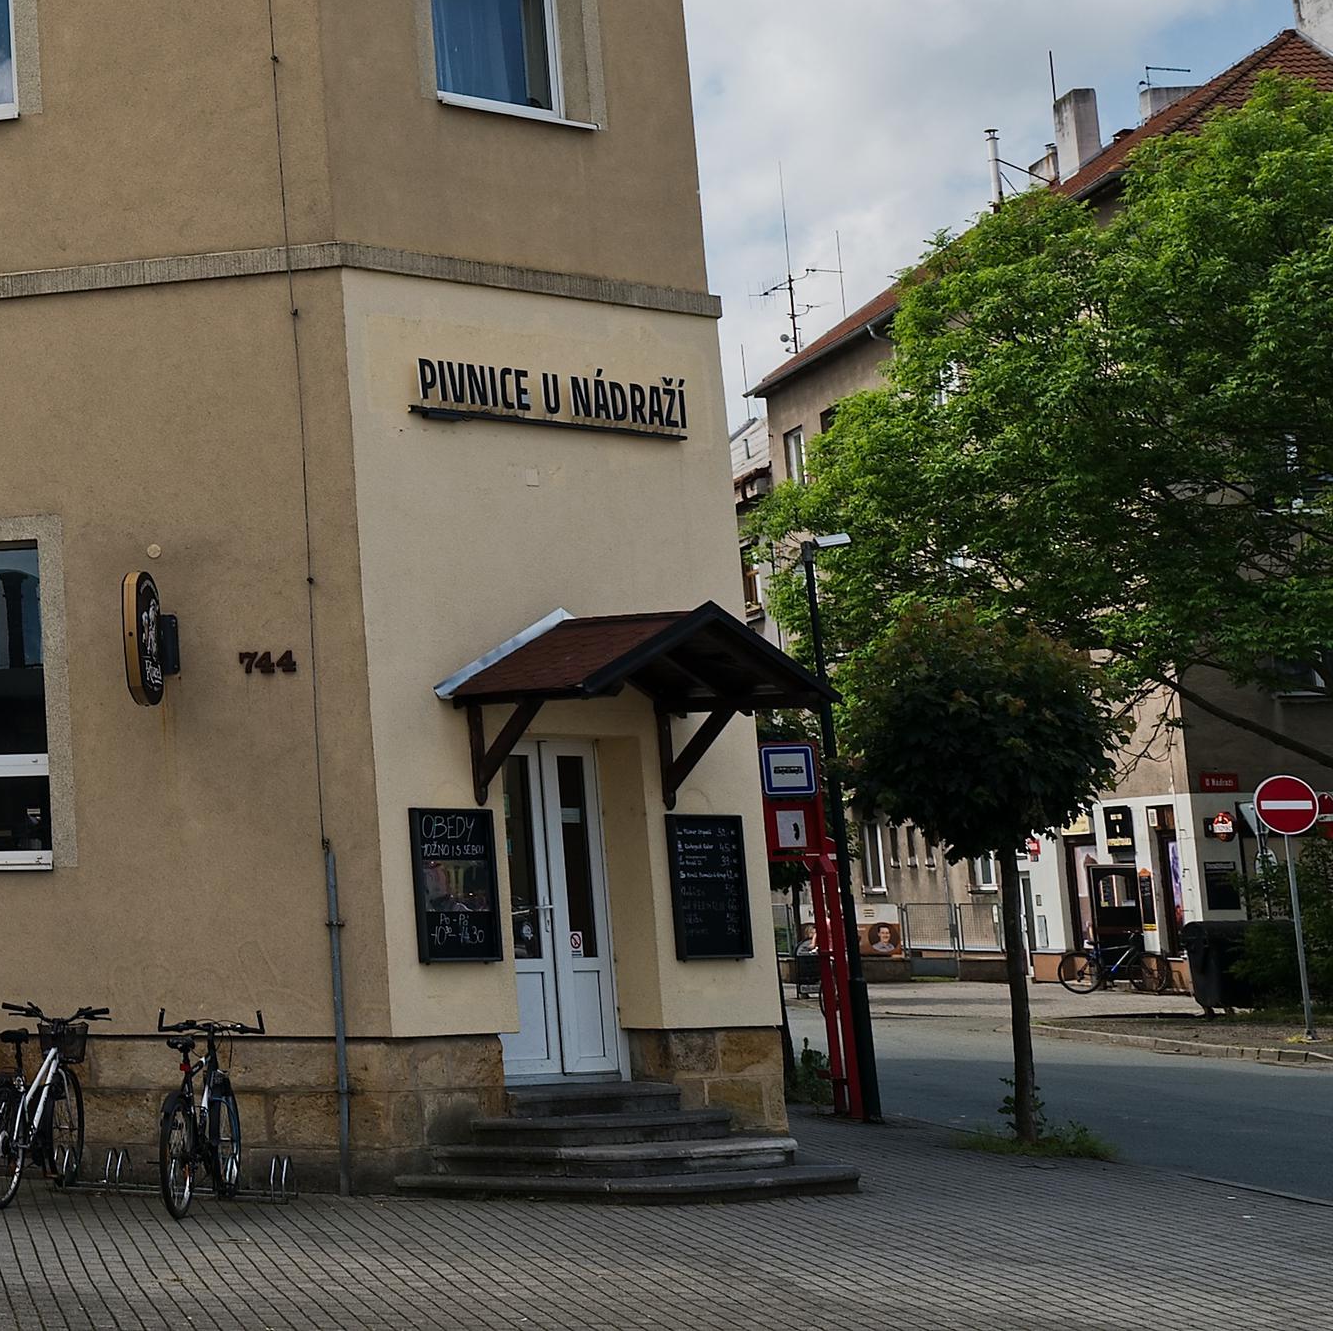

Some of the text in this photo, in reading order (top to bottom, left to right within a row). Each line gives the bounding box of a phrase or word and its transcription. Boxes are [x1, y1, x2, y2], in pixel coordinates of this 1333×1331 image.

[418, 358, 687, 429] PIVNICE U NÁDRAŽÍ
[239, 649, 297, 674] 744
